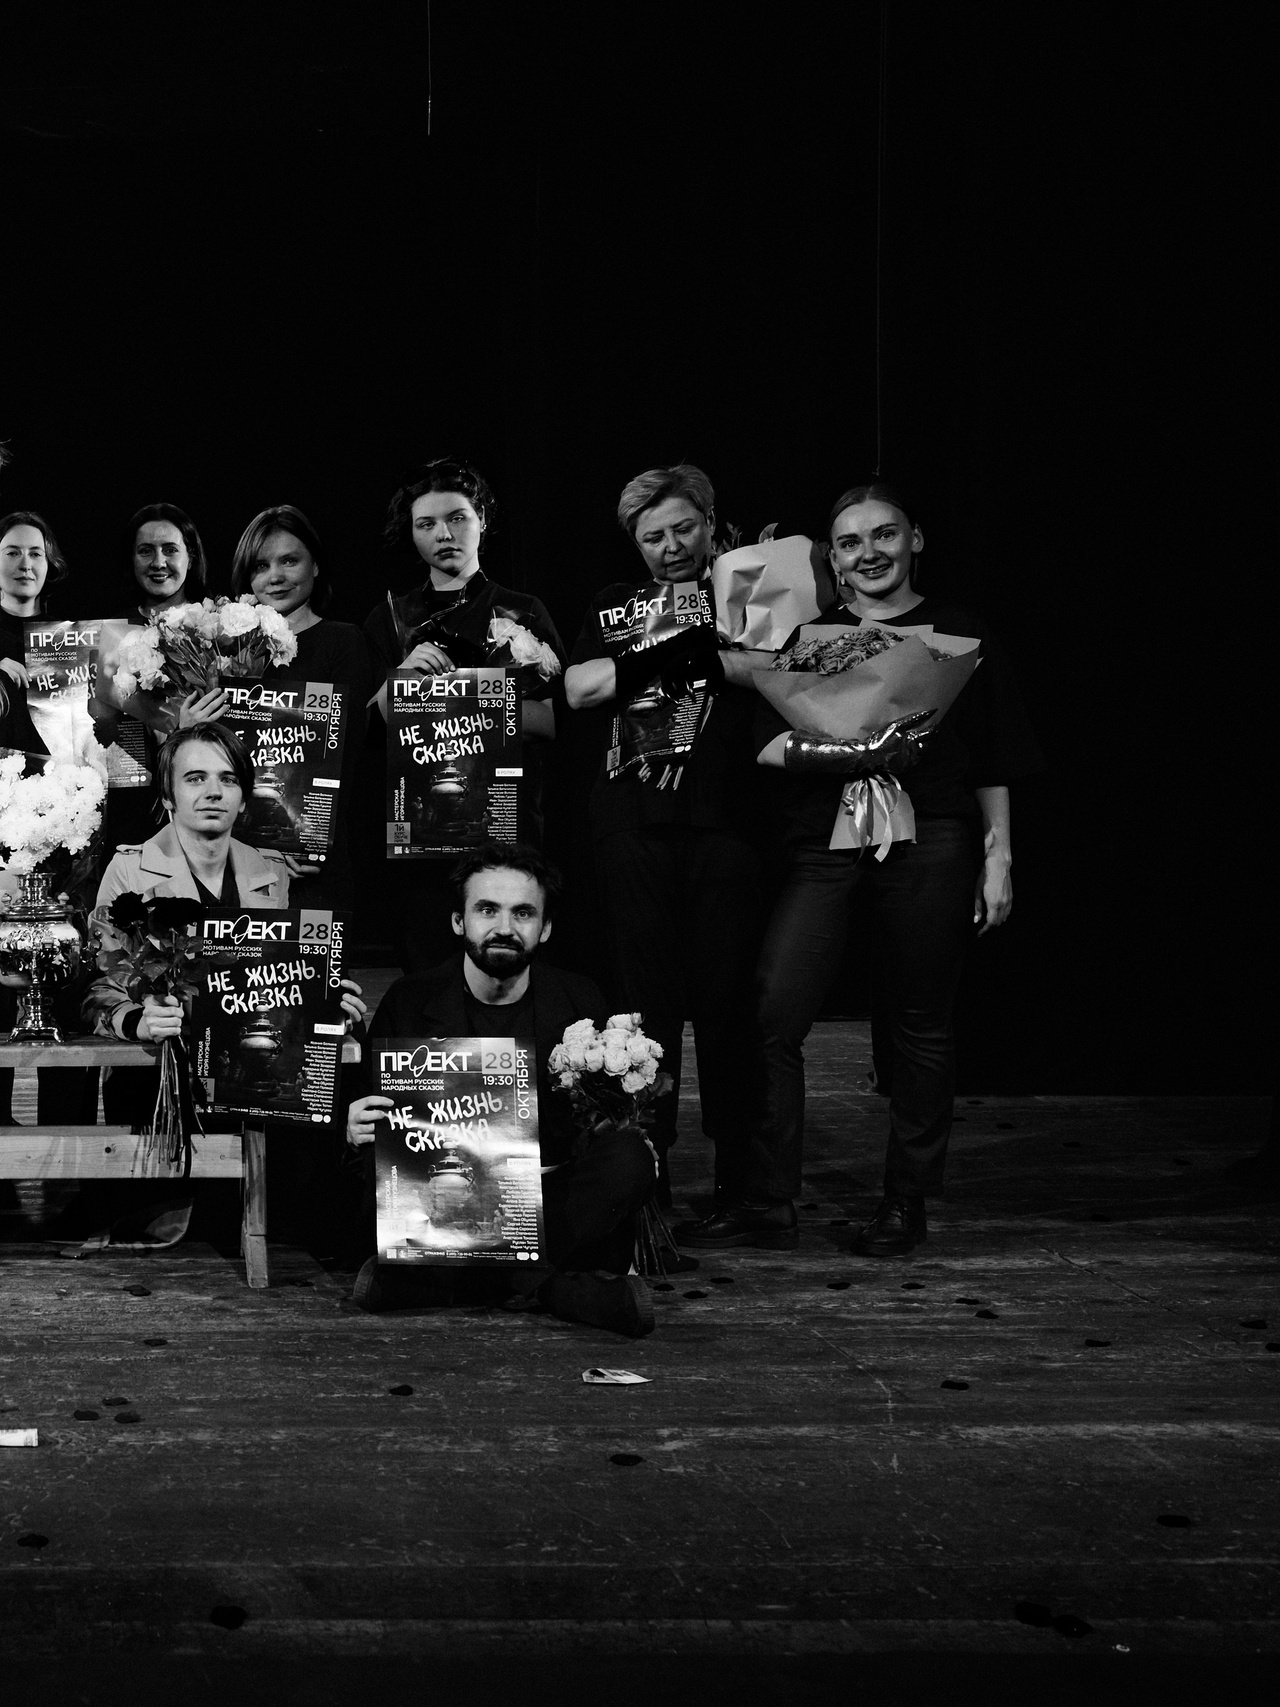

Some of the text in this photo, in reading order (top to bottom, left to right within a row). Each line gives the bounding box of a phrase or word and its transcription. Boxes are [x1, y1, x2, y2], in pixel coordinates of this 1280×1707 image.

[676, 593, 699, 611] 28
[675, 613, 701, 625] 19:30
[29, 627, 98, 652] ПРОЕКТ
[36, 673, 59, 692] НЕ
[393, 674, 471, 702] ПРОЕКТ
[480, 680, 503, 694] 28
[306, 694, 330, 708] 28
[477, 699, 503, 708] 19:30
[505, 677, 517, 736] ОКТЯБРЯ
[303, 712, 328, 722] 19:30
[327, 693, 343, 750] ОКТЯБРЯ
[398, 724, 425, 747] НЕ
[412, 735, 485, 765] СКАЗКА
[203, 914, 292, 945] ПРОЕКТ
[301, 923, 329, 939] 28
[298, 944, 328, 955] 19:30
[329, 921, 344, 988] ОКТЯБРЯ
[207, 970, 235, 993] НЕ
[220, 985, 303, 1015] СКАЗКА
[379, 1044, 472, 1078] ПРОЕКТ
[484, 1052, 513, 1069] 28
[482, 1075, 513, 1086] 19:30
[516, 1049, 531, 1119] ОКТЯБРЯ
[386, 1105, 414, 1131] НЕ
